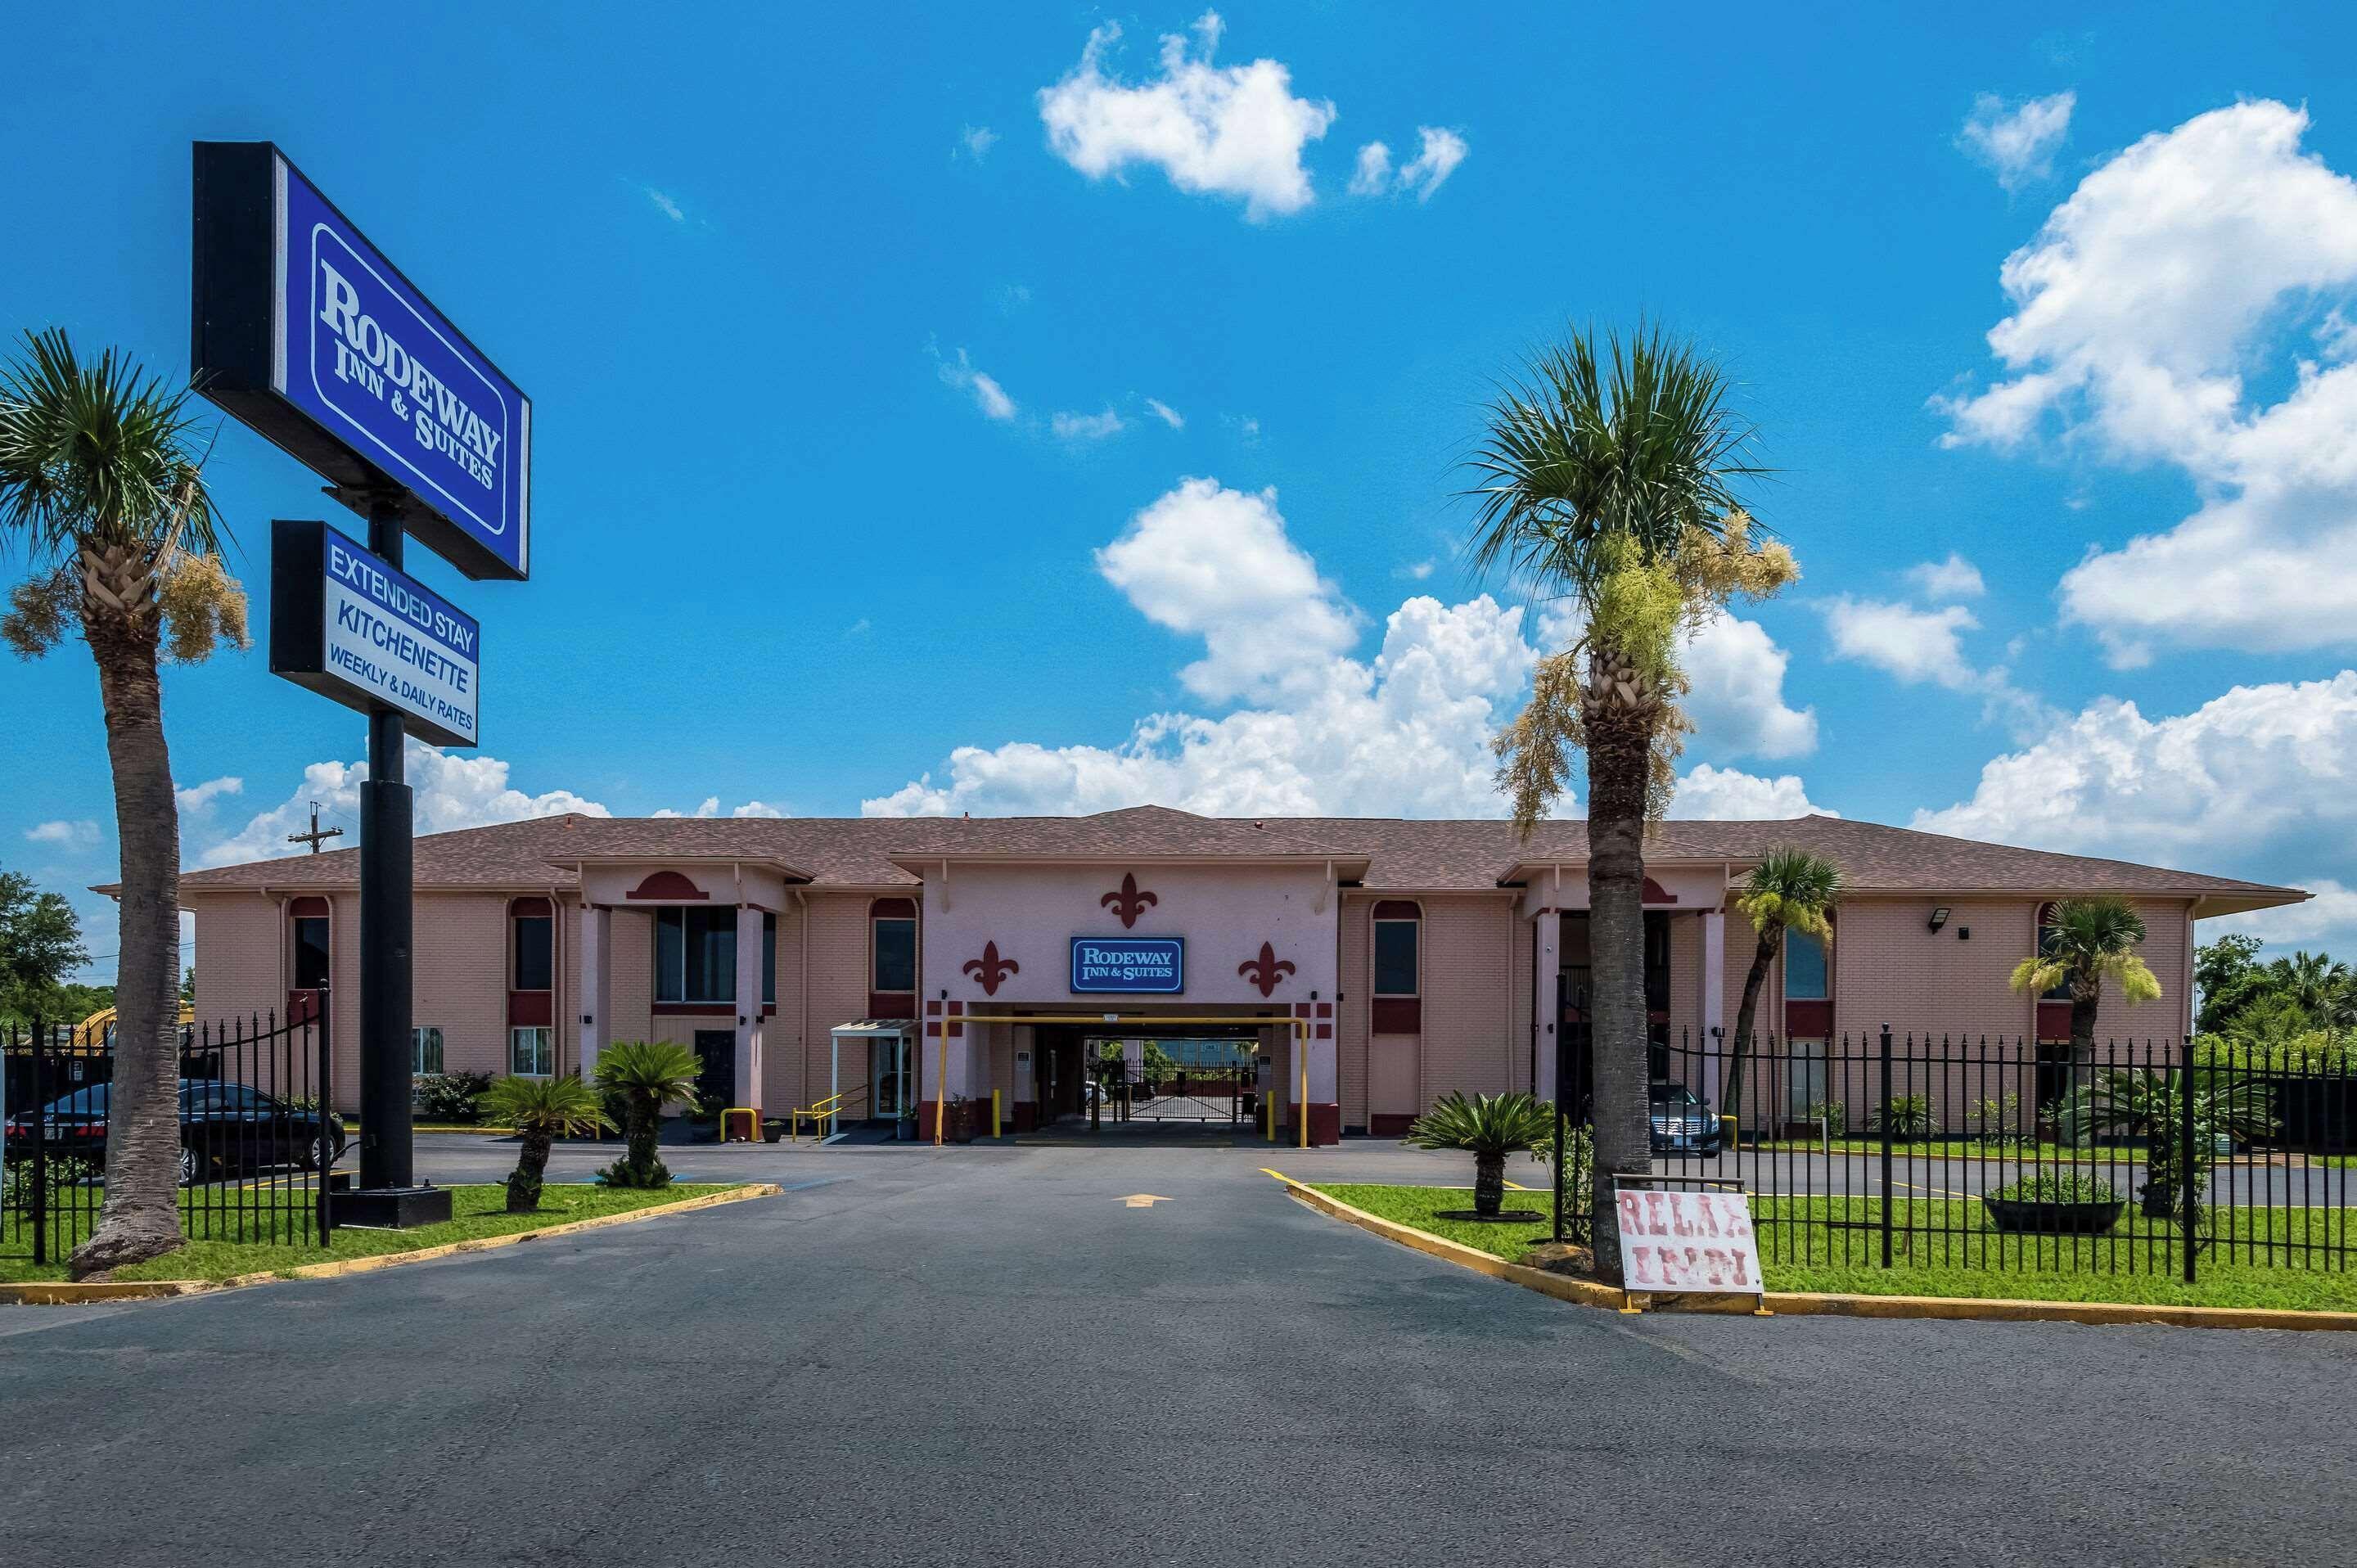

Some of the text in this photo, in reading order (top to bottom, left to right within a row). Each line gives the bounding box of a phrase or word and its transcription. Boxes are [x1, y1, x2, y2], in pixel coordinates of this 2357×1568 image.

[320, 258, 501, 469] RODEWAY
[335, 338, 493, 490] INN & SUITES
[331, 543, 474, 653] EXTENDED STAY
[331, 642, 472, 731] WEEKLY & DAILY RATES
[338, 599, 468, 694] KITCHENETTE
[1082, 966, 1173, 980] INN & SUITES
[1083, 948, 1173, 965] RODEWAY
